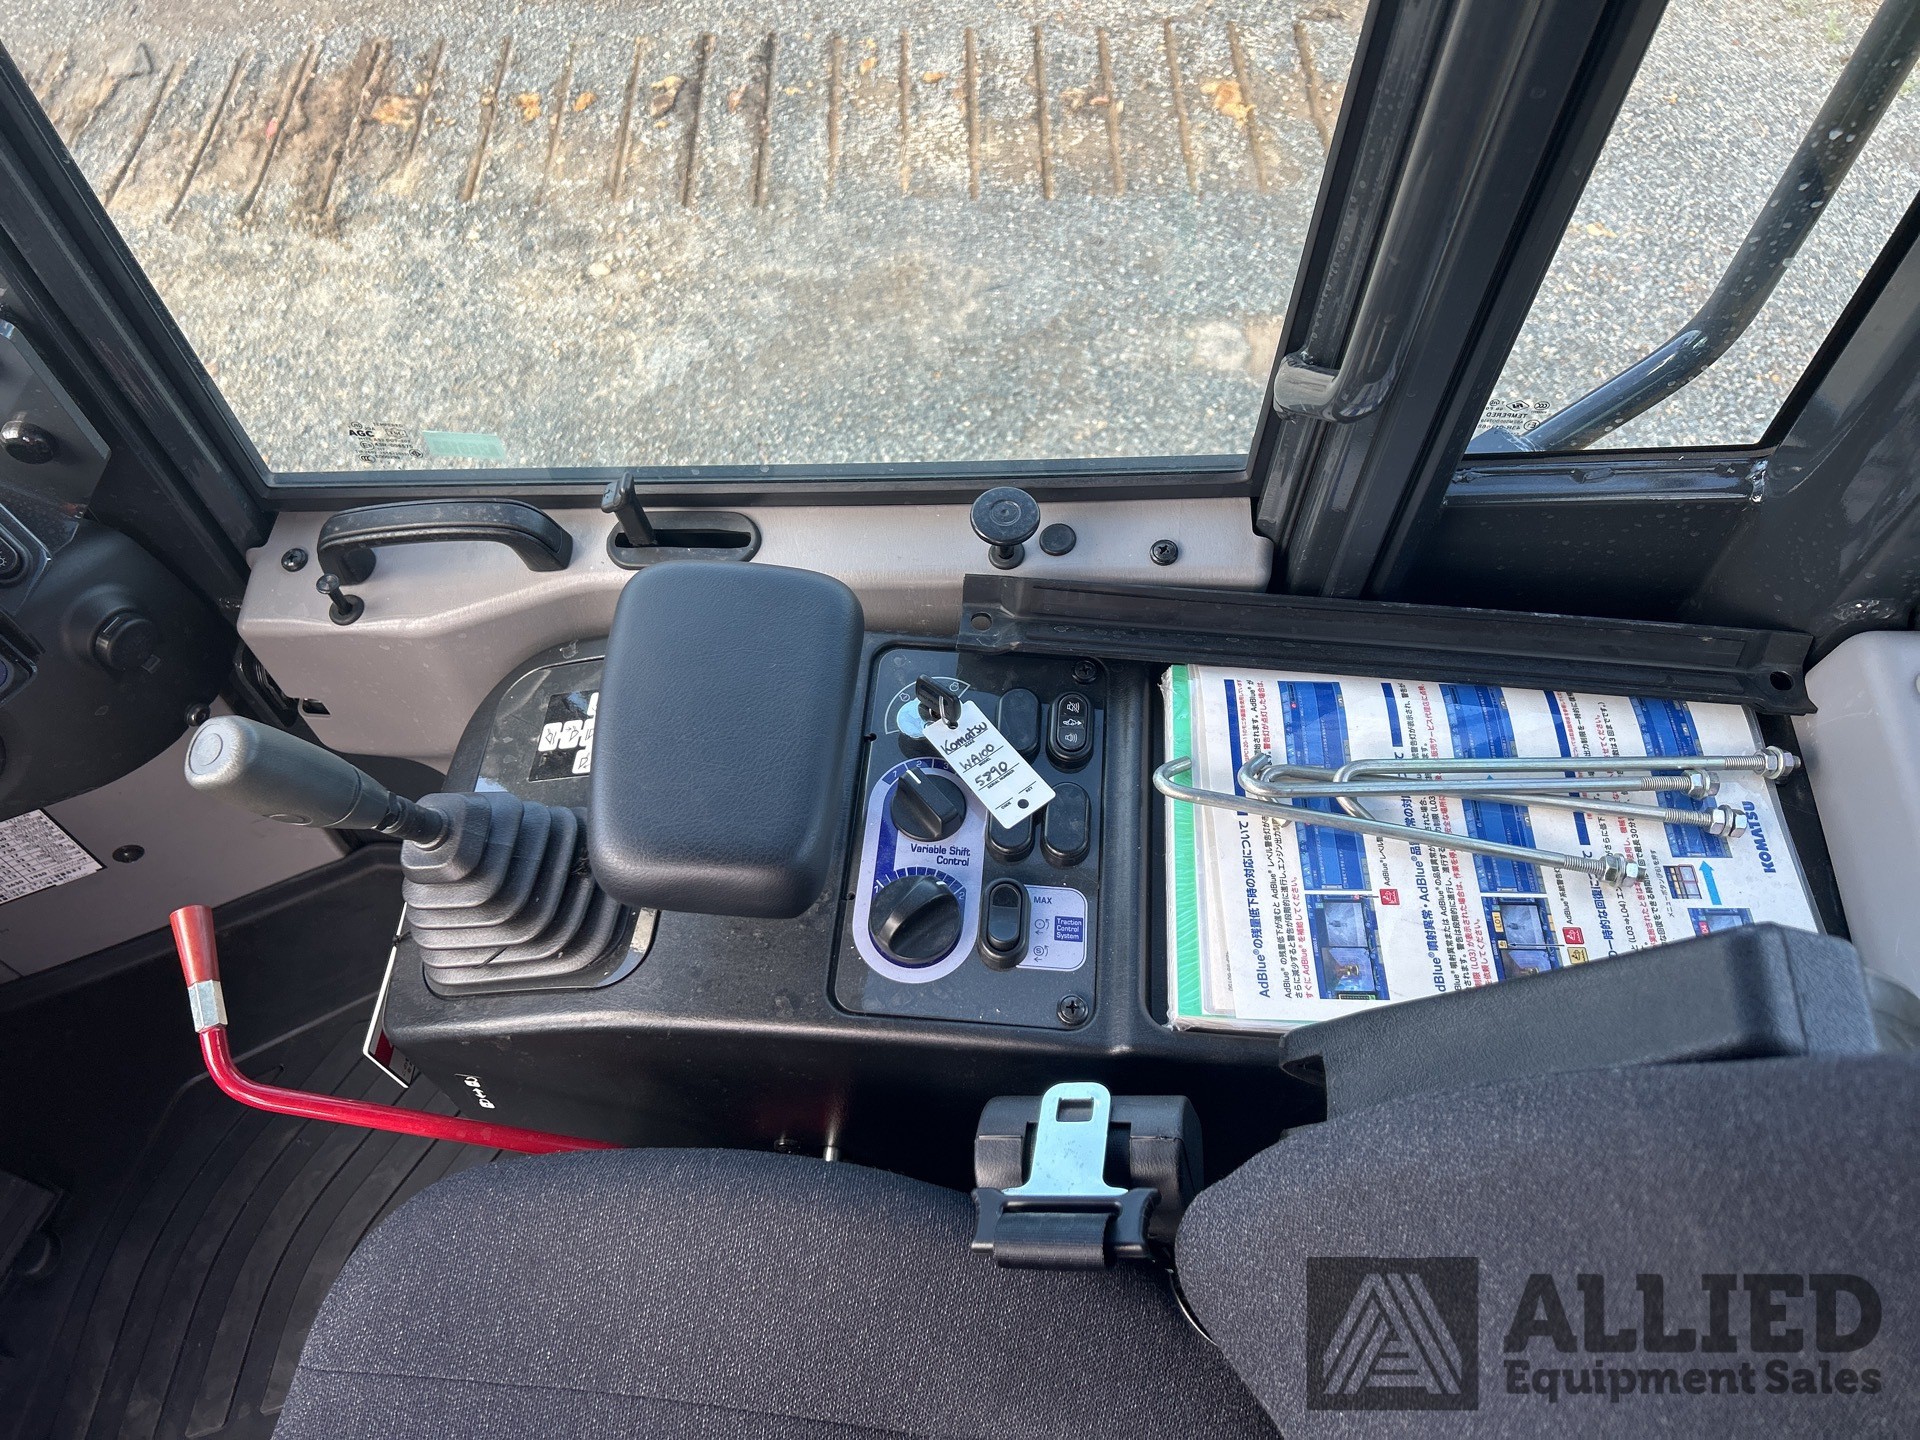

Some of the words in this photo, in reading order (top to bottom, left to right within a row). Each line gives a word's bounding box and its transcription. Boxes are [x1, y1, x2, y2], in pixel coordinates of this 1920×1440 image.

[349, 429, 374, 437] AGC
[940, 721, 988, 755] Komatsu
[974, 761, 1008, 786] 5890
[1741, 800, 1777, 873] KOMATSU
[910, 843, 947, 855] Variable
[949, 845, 971, 857] Shift
[936, 855, 970, 867] Control
[1033, 896, 1053, 904] MAX
[1238, 821, 1271, 998] AdBlue®の残量低下時の対応について
[1056, 917, 1082, 926] Traction
[1056, 932, 1080, 940] System
